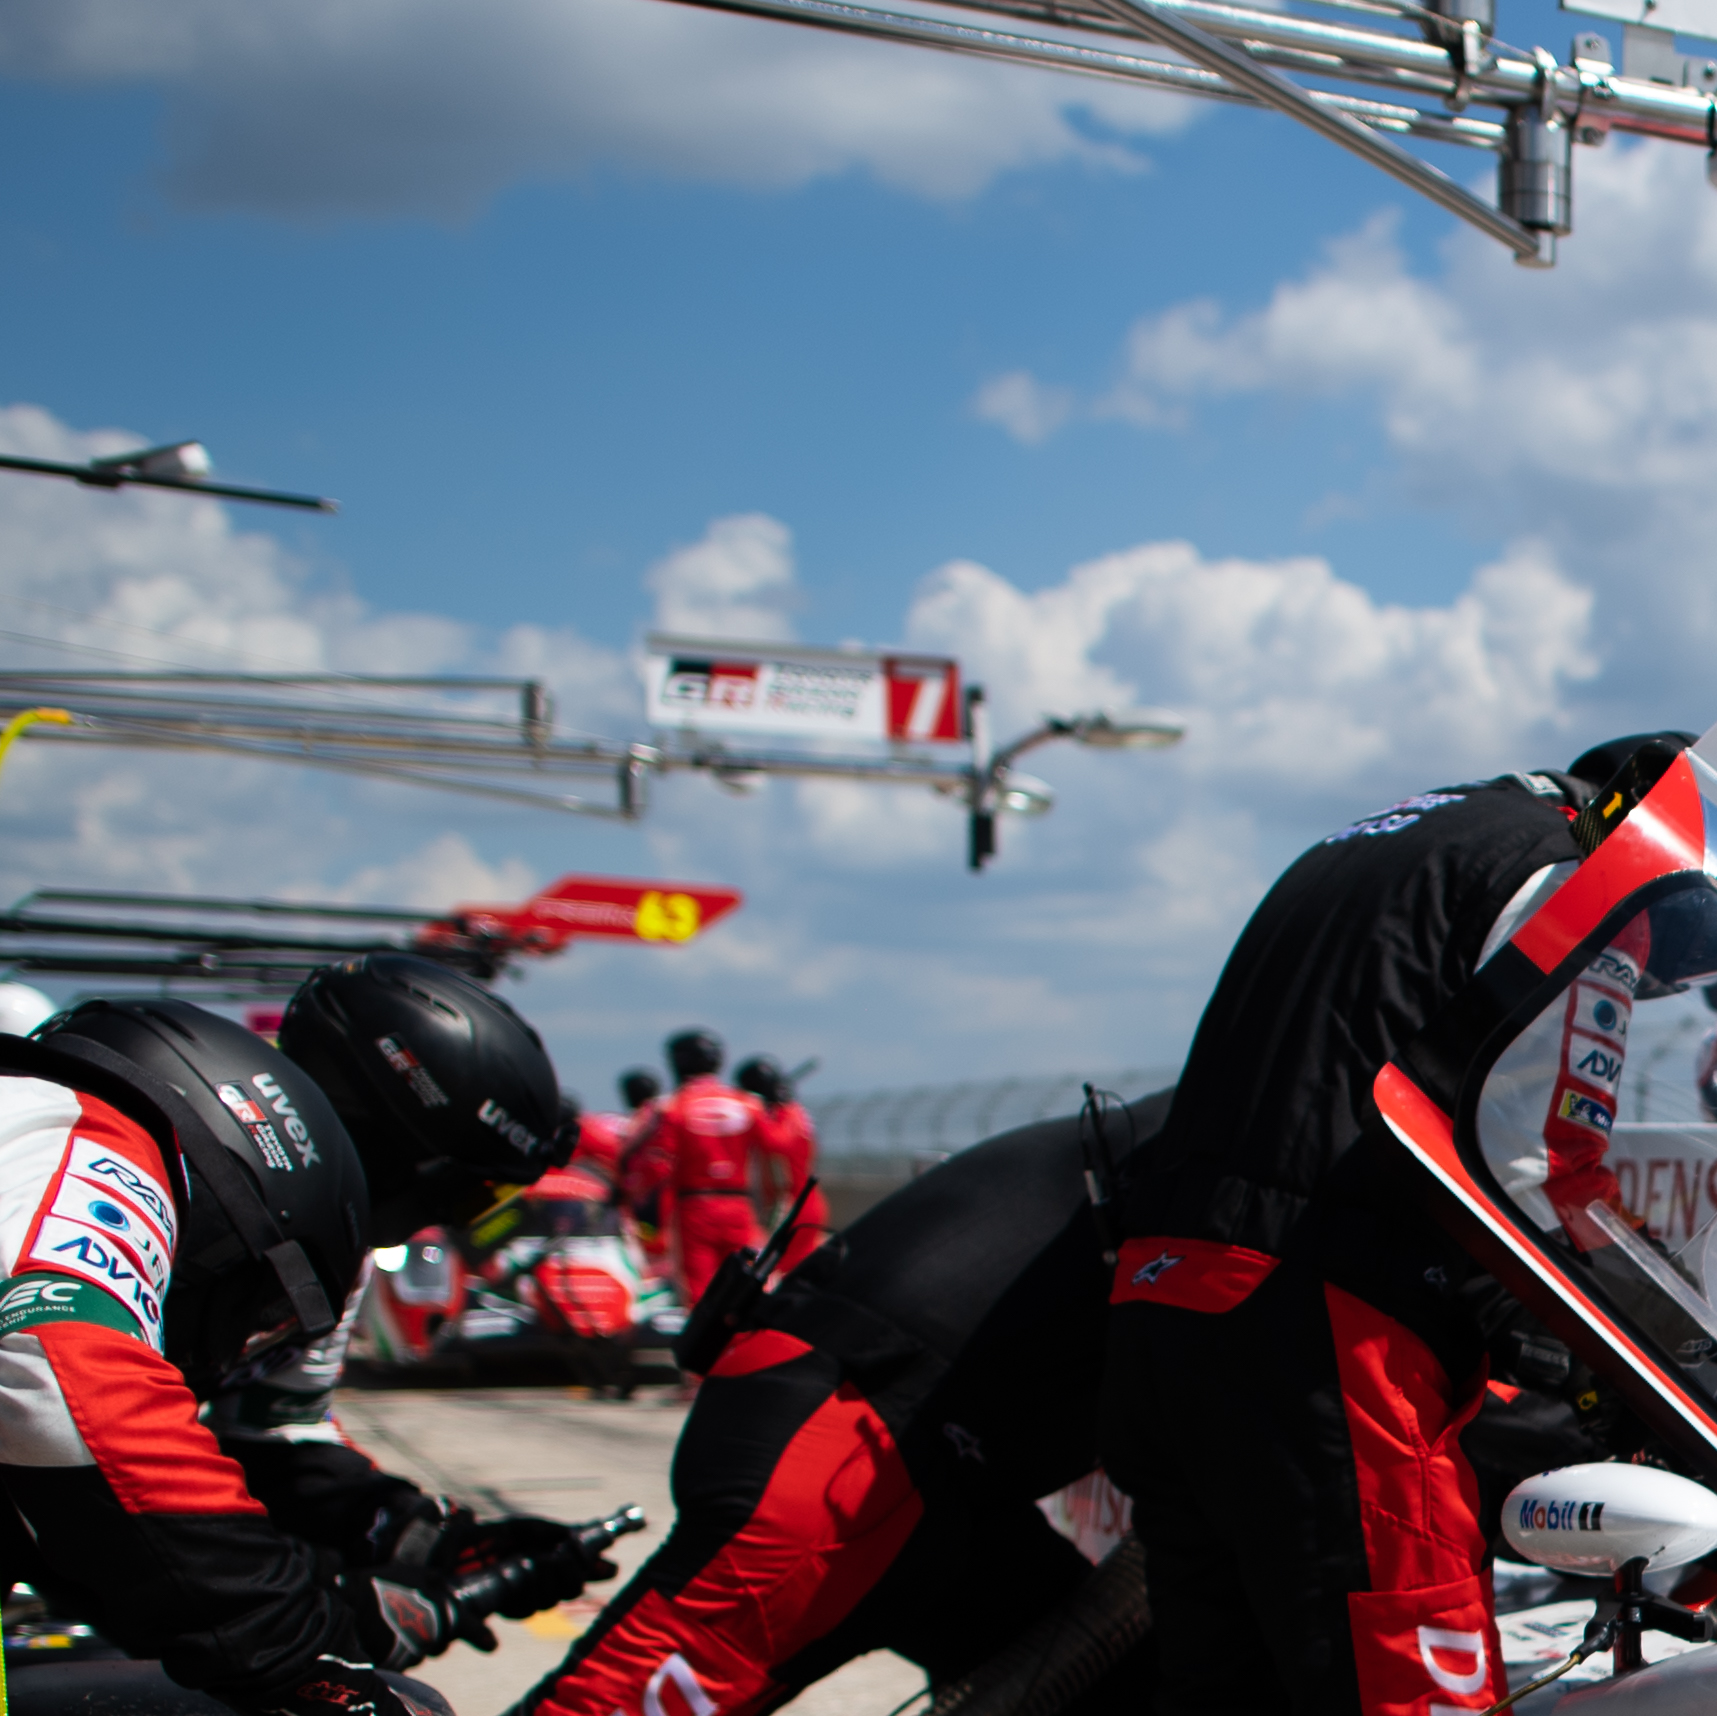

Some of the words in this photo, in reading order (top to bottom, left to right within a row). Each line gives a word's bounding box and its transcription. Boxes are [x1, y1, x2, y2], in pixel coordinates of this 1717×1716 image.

[894, 660, 946, 736] 7
[252, 1072, 321, 1168] uvex
[477, 1098, 538, 1157] uvex
[1519, 1500, 1575, 1531] Mobil
